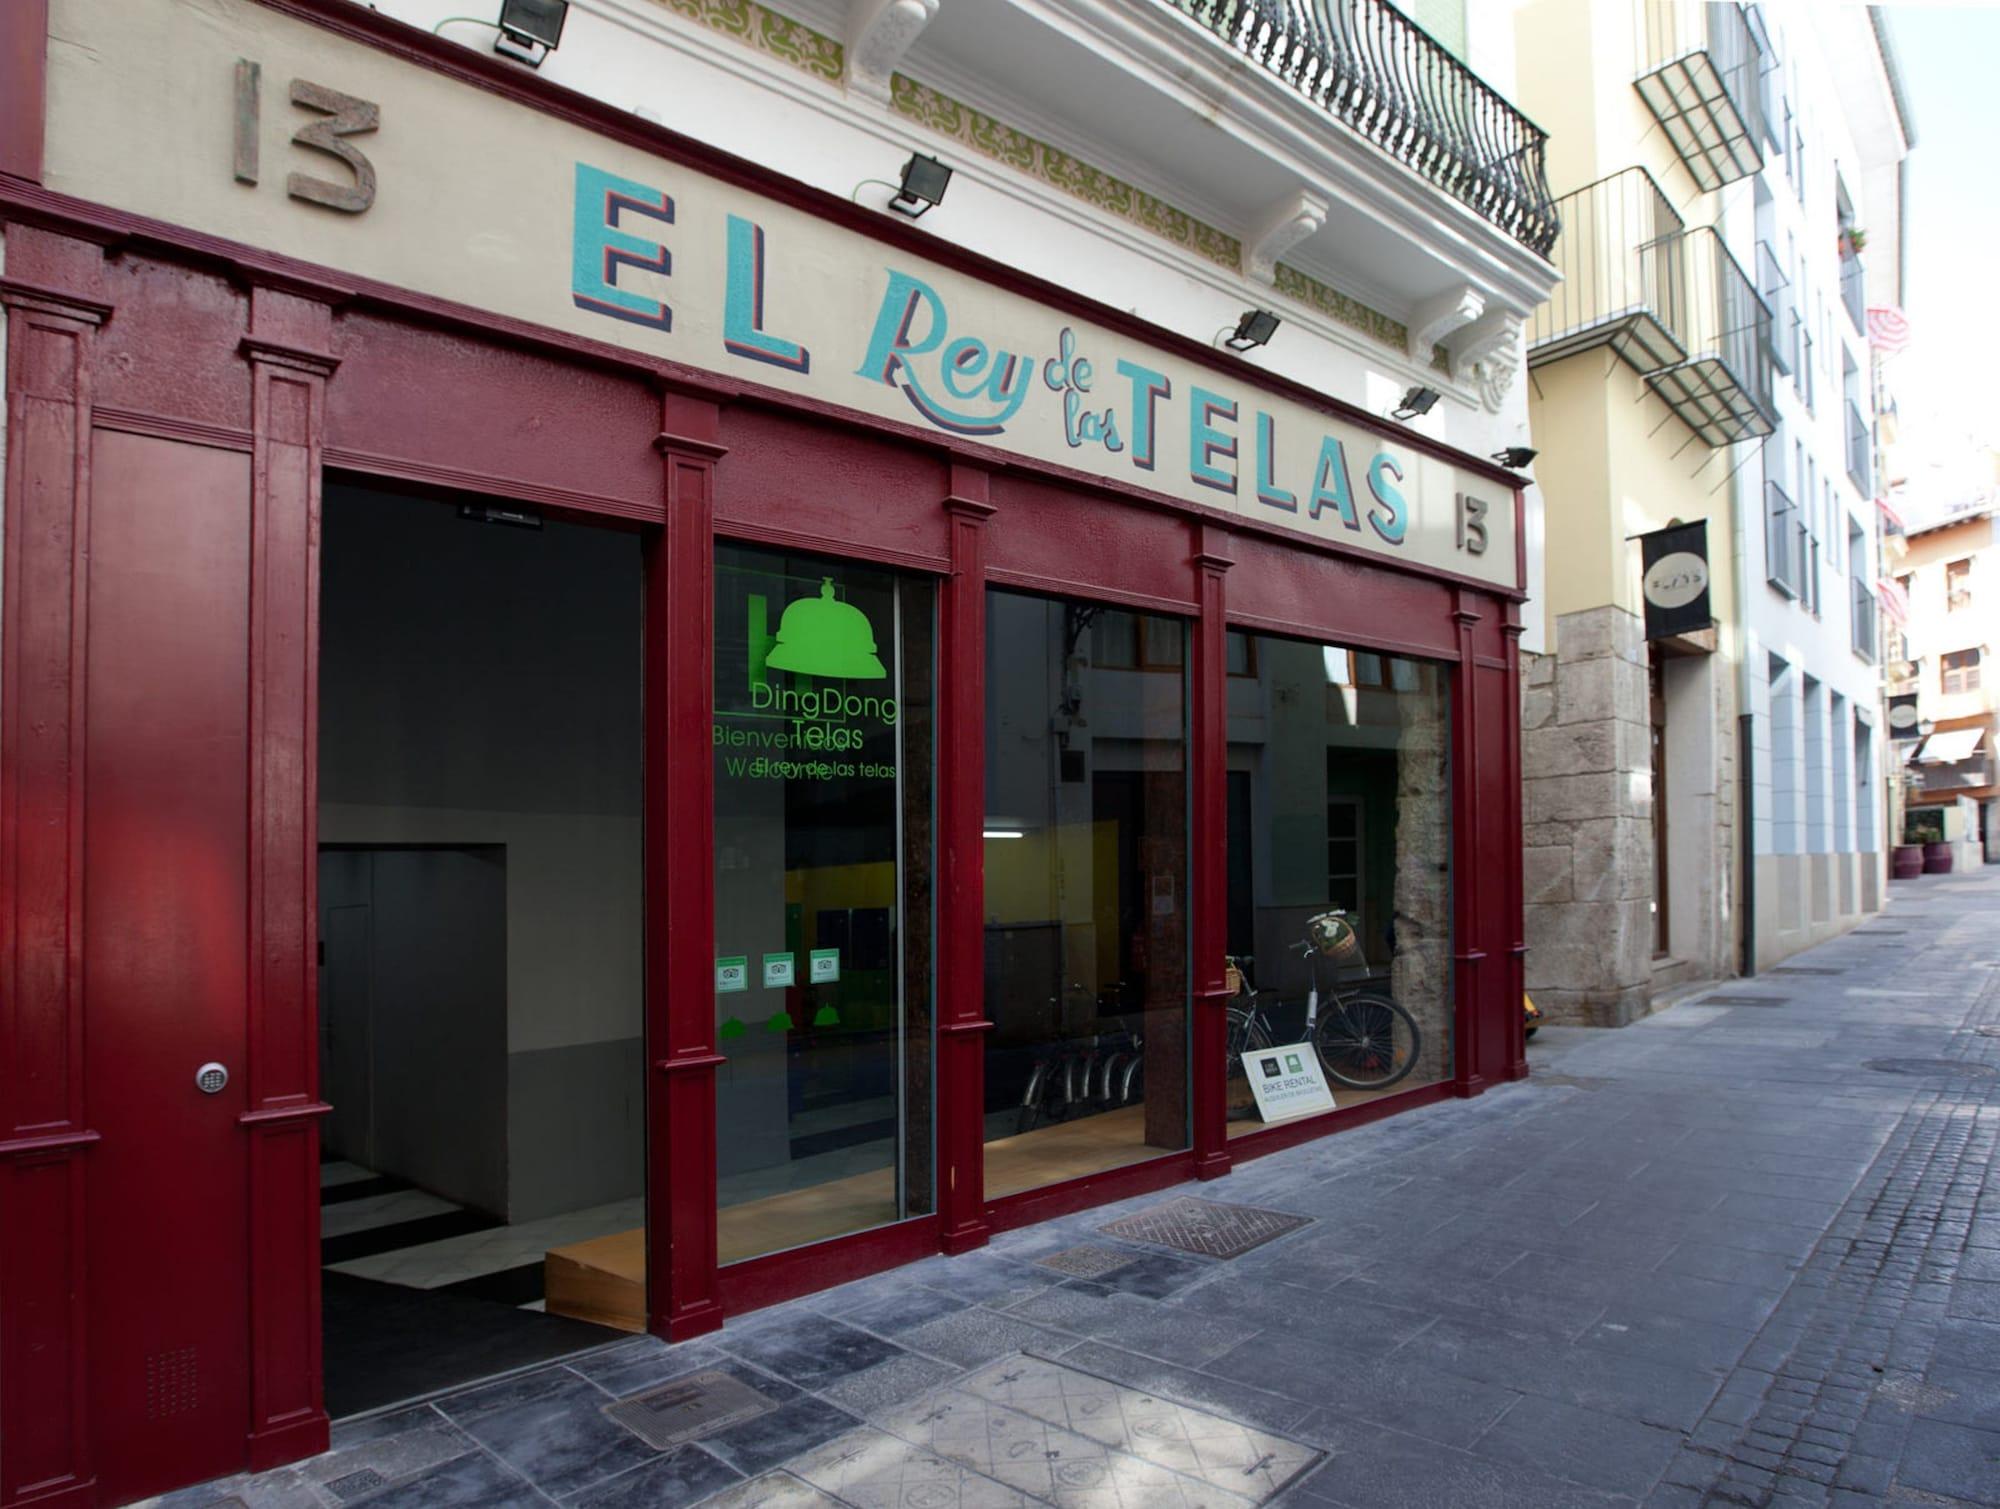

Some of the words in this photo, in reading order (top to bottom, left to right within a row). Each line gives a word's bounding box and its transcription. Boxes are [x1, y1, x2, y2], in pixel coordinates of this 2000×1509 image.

[233, 58, 380, 214] 13
[573, 161, 809, 375] EL
[854, 268, 1035, 437] Rey
[1042, 327, 1093, 393] de
[1061, 389, 1124, 452] las
[1117, 358, 1408, 546] TELAS
[1455, 491, 1489, 555] 13
[752, 682, 898, 725] DingDong
[792, 719, 864, 750] Telas
[833, 761, 855, 777] las
[860, 763, 896, 779] telas
